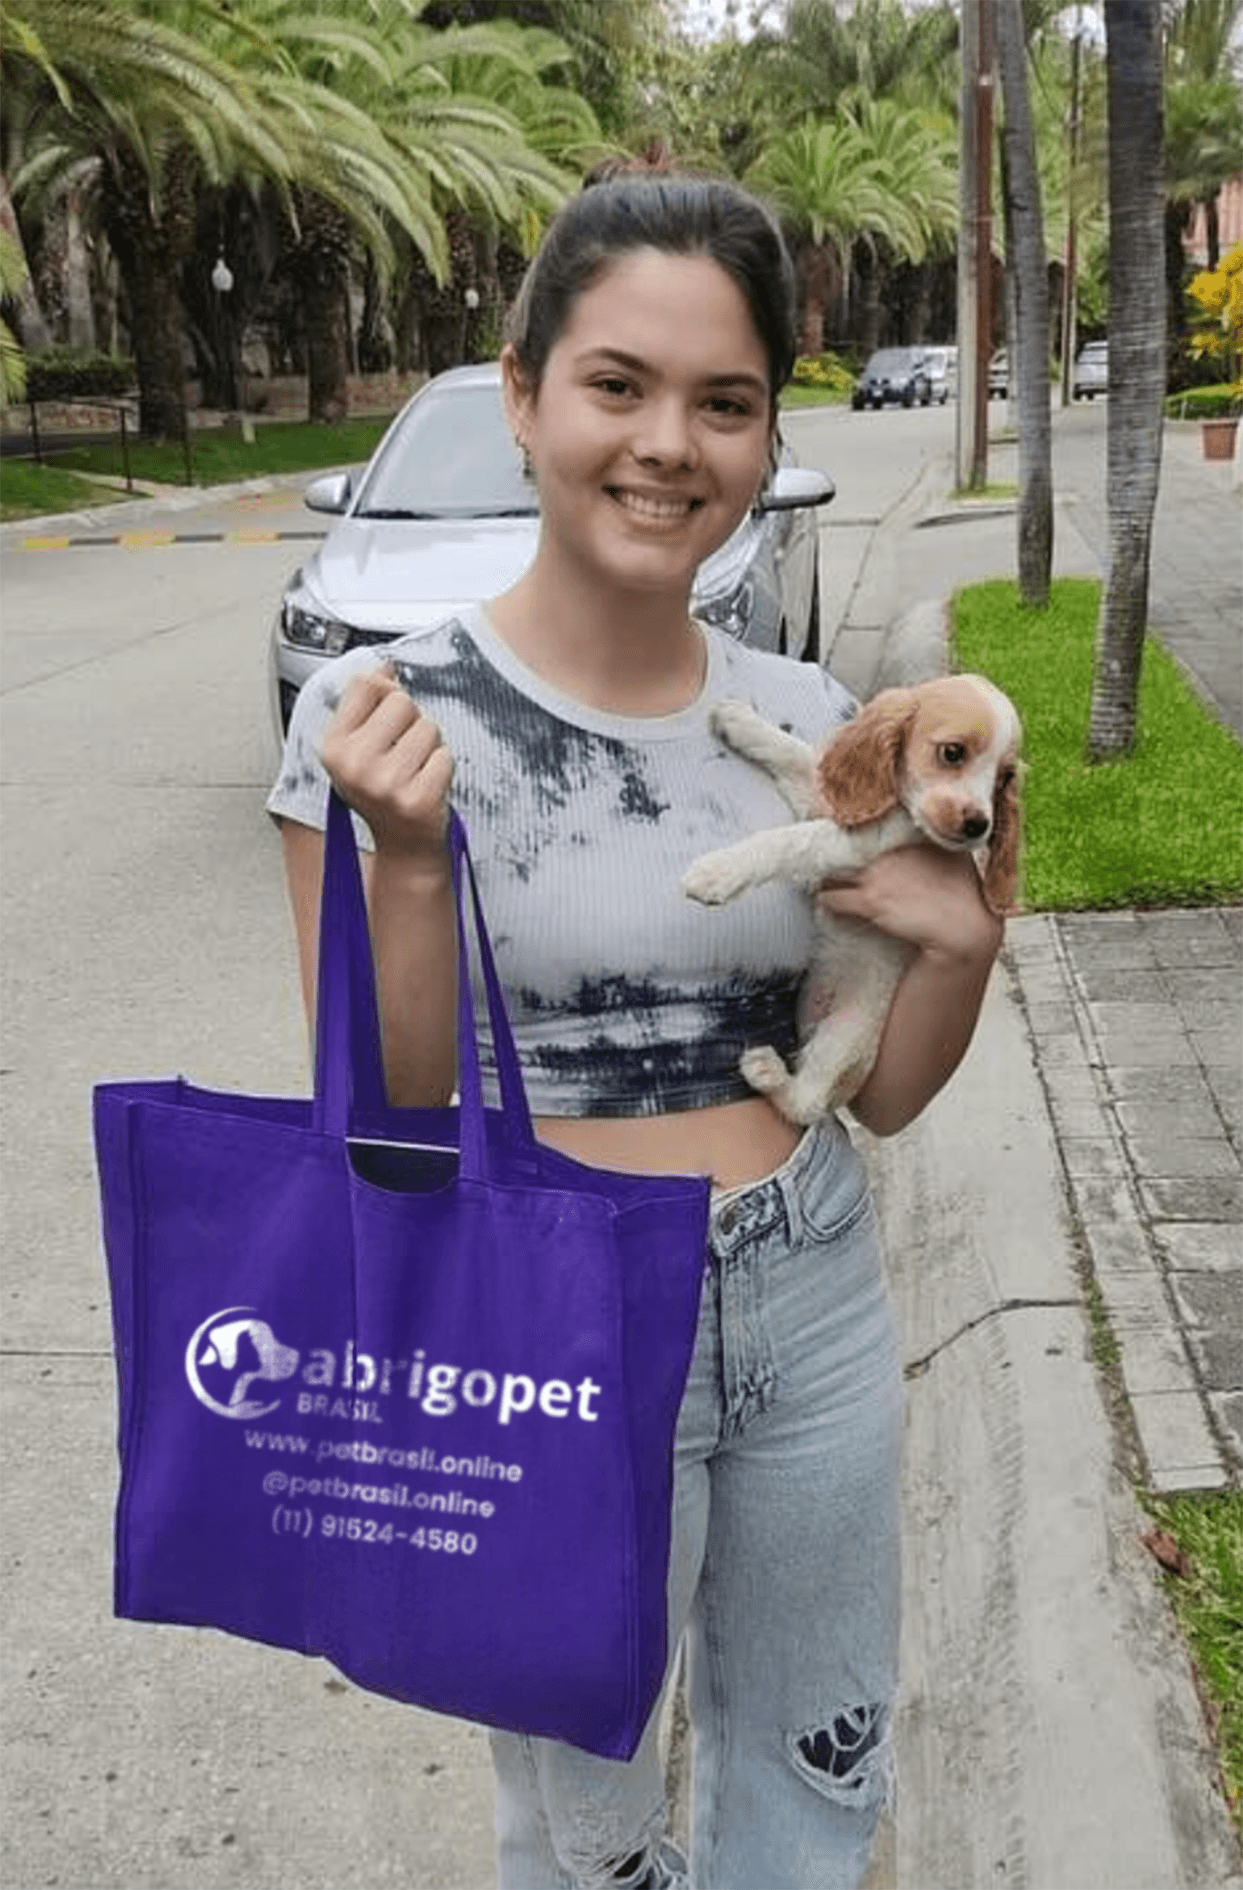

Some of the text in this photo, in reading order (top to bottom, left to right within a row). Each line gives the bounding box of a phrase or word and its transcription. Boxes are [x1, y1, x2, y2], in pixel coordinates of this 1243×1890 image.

[302, 1339, 601, 1424] abrigopet
[296, 1392, 384, 1423] BRASIL
[245, 1429, 523, 1483] www.petbrasil.online
[262, 1470, 495, 1518] @petbrasil.online
[272, 1504, 478, 1555] (11) 91524-4580
